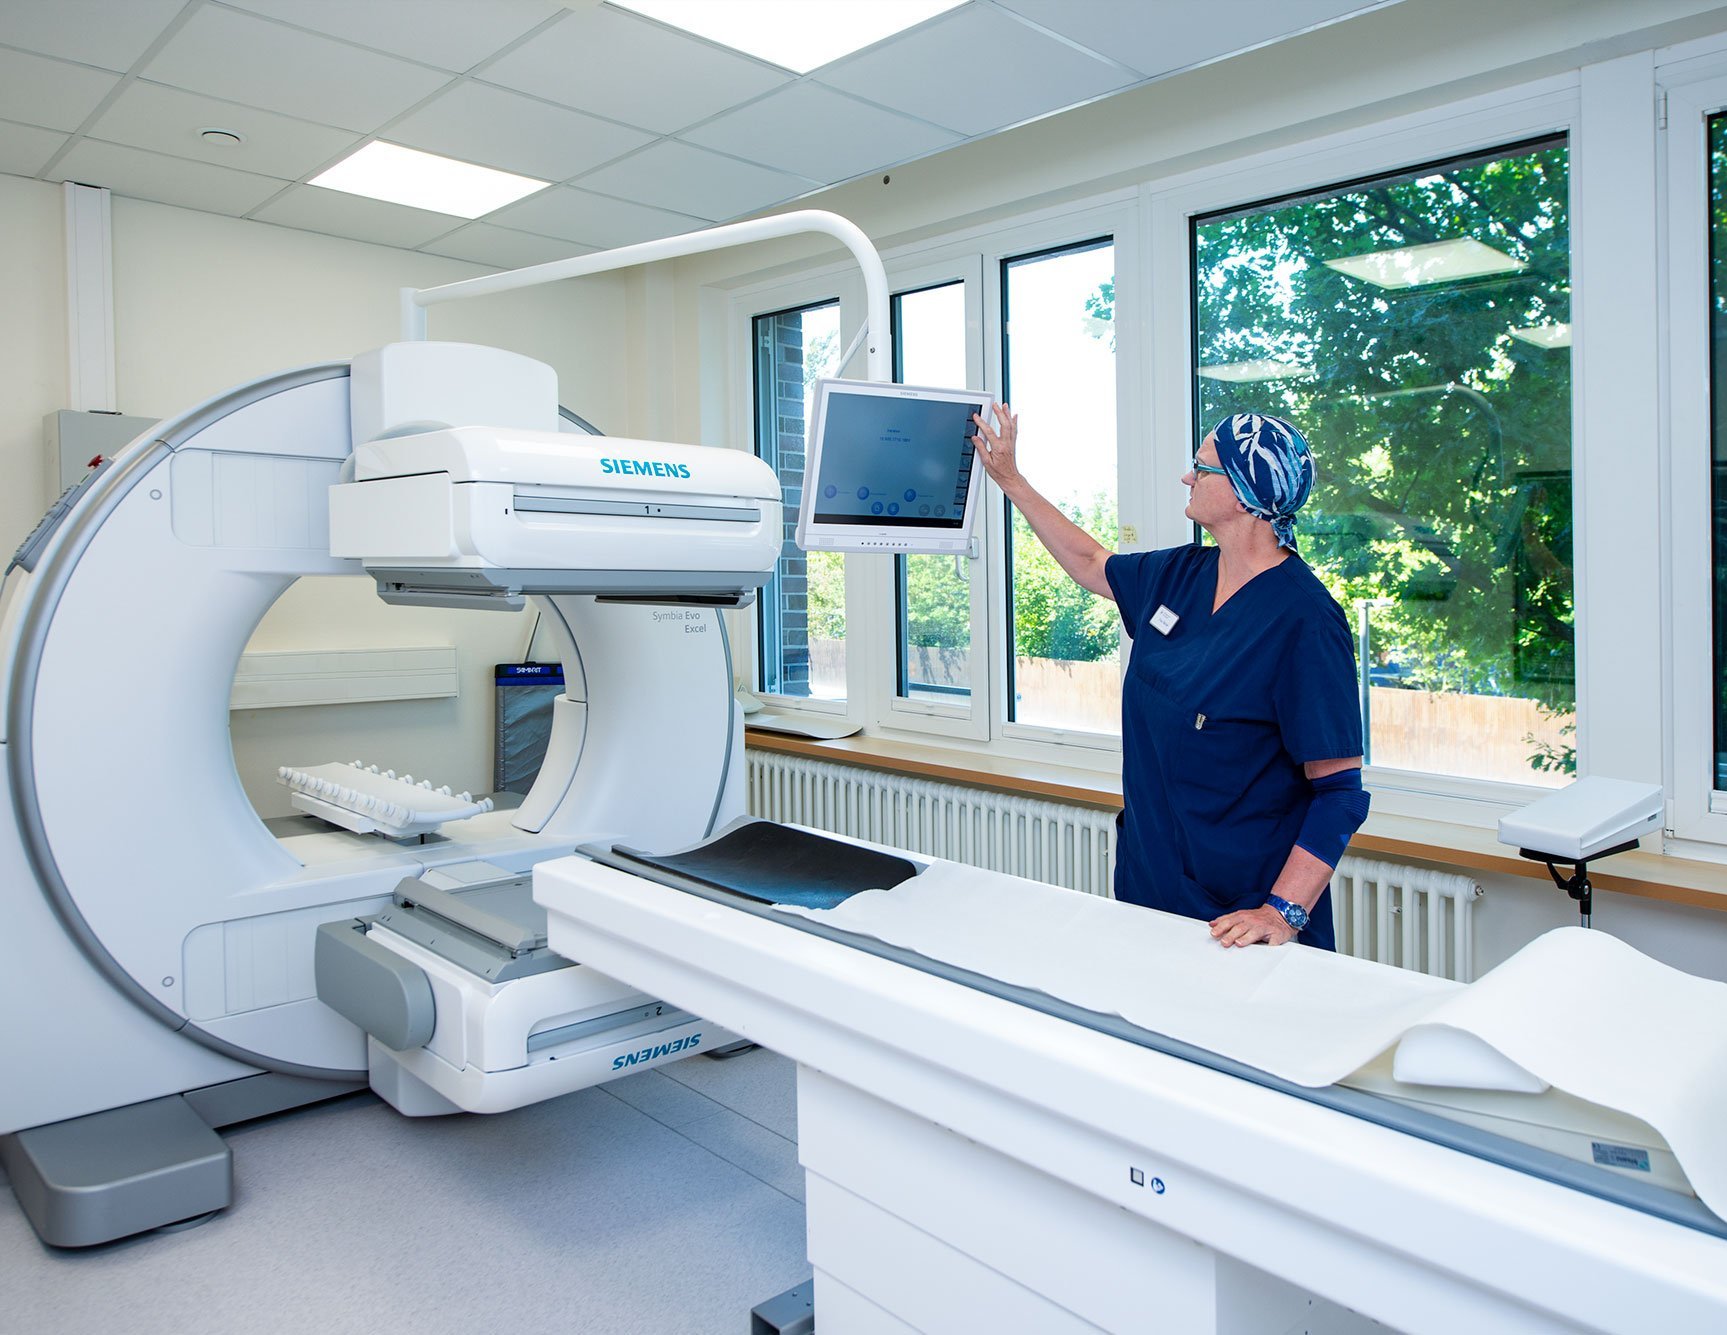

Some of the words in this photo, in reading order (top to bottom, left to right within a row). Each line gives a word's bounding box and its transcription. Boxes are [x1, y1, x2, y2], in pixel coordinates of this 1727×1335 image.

[600, 458, 691, 479] SIEMENS
[644, 505, 650, 514] 1
[652, 611, 683, 623] Symbia
[685, 611, 701, 620] Evo
[684, 624, 707, 633] Excel
[656, 1006, 662, 1016] 2
[612, 1033, 702, 1071] SIEMENS
